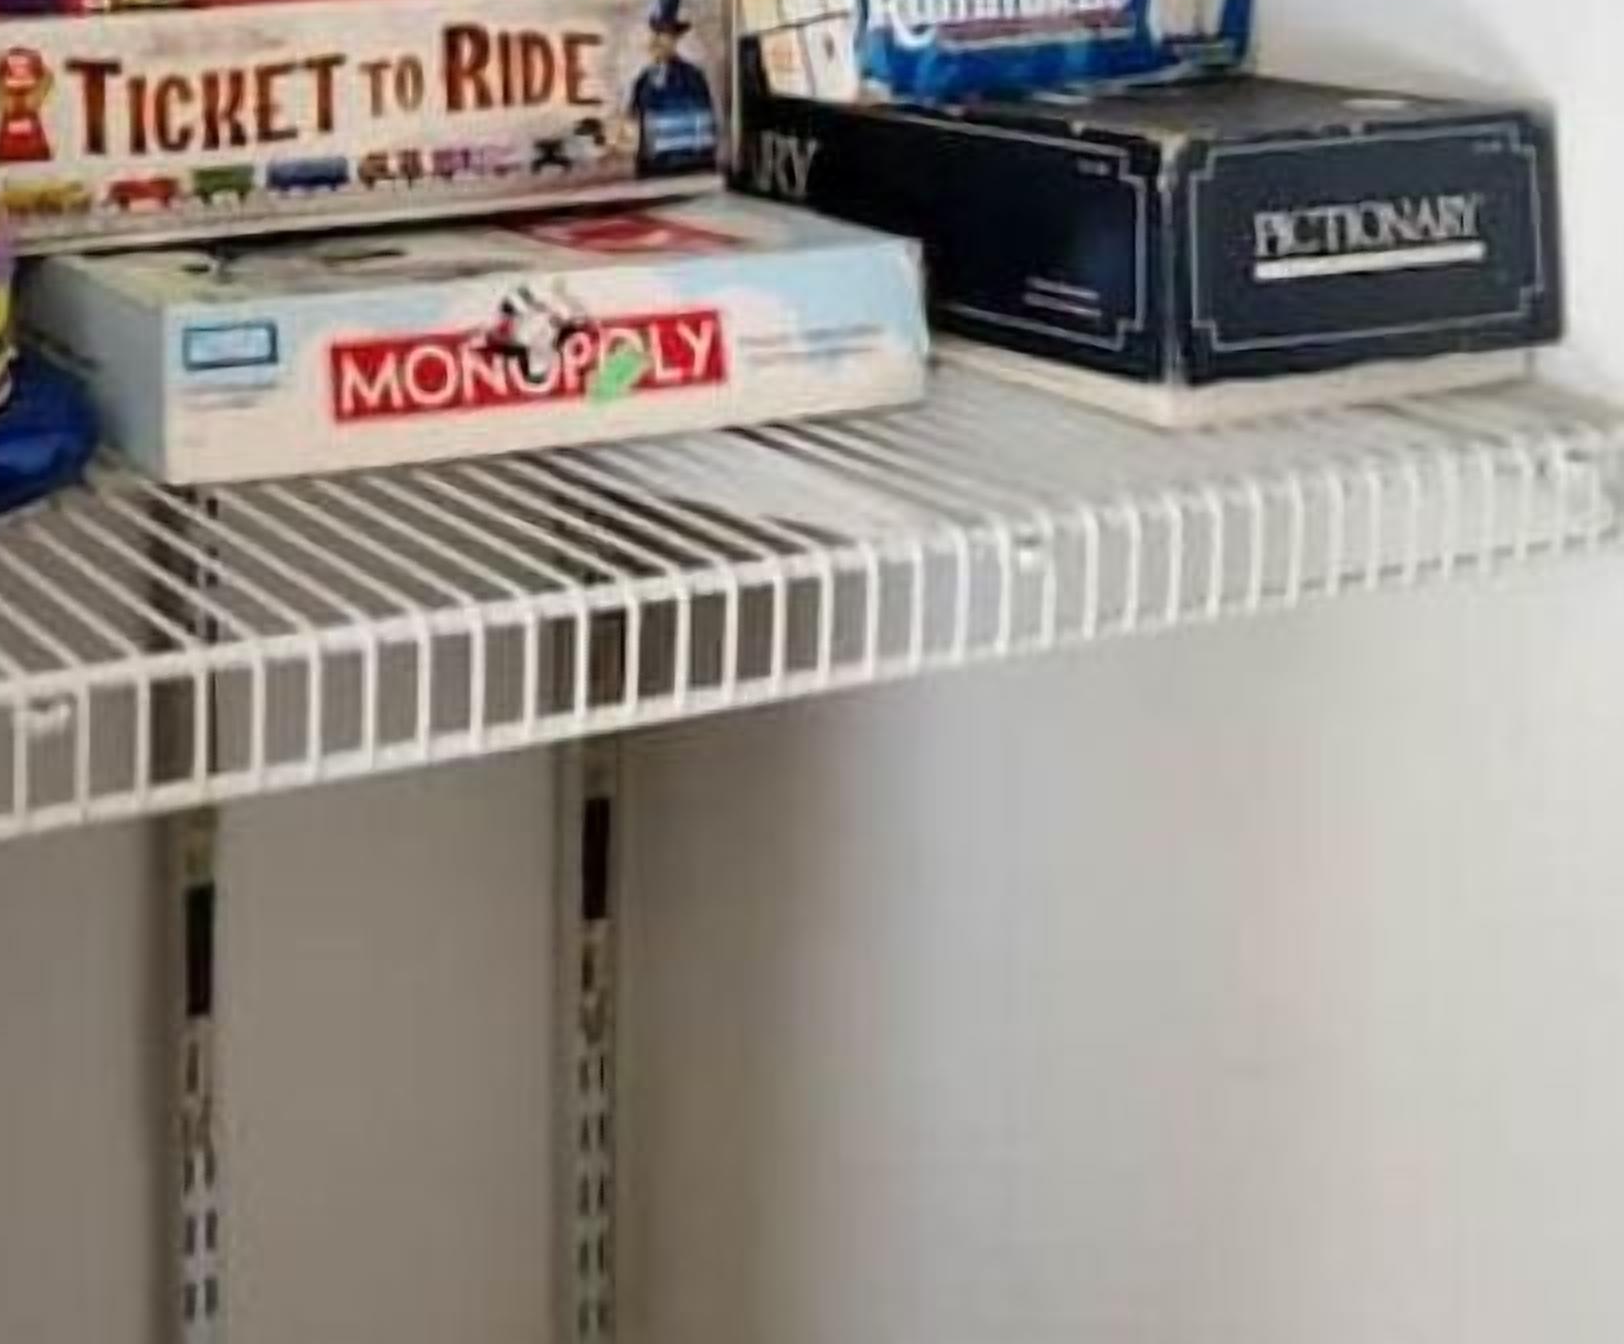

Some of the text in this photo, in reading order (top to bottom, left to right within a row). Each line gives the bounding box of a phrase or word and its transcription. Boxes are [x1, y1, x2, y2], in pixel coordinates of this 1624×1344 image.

[64, 26, 604, 156] TICKET TO RIDE
[1254, 191, 1483, 258] PICTIONARY
